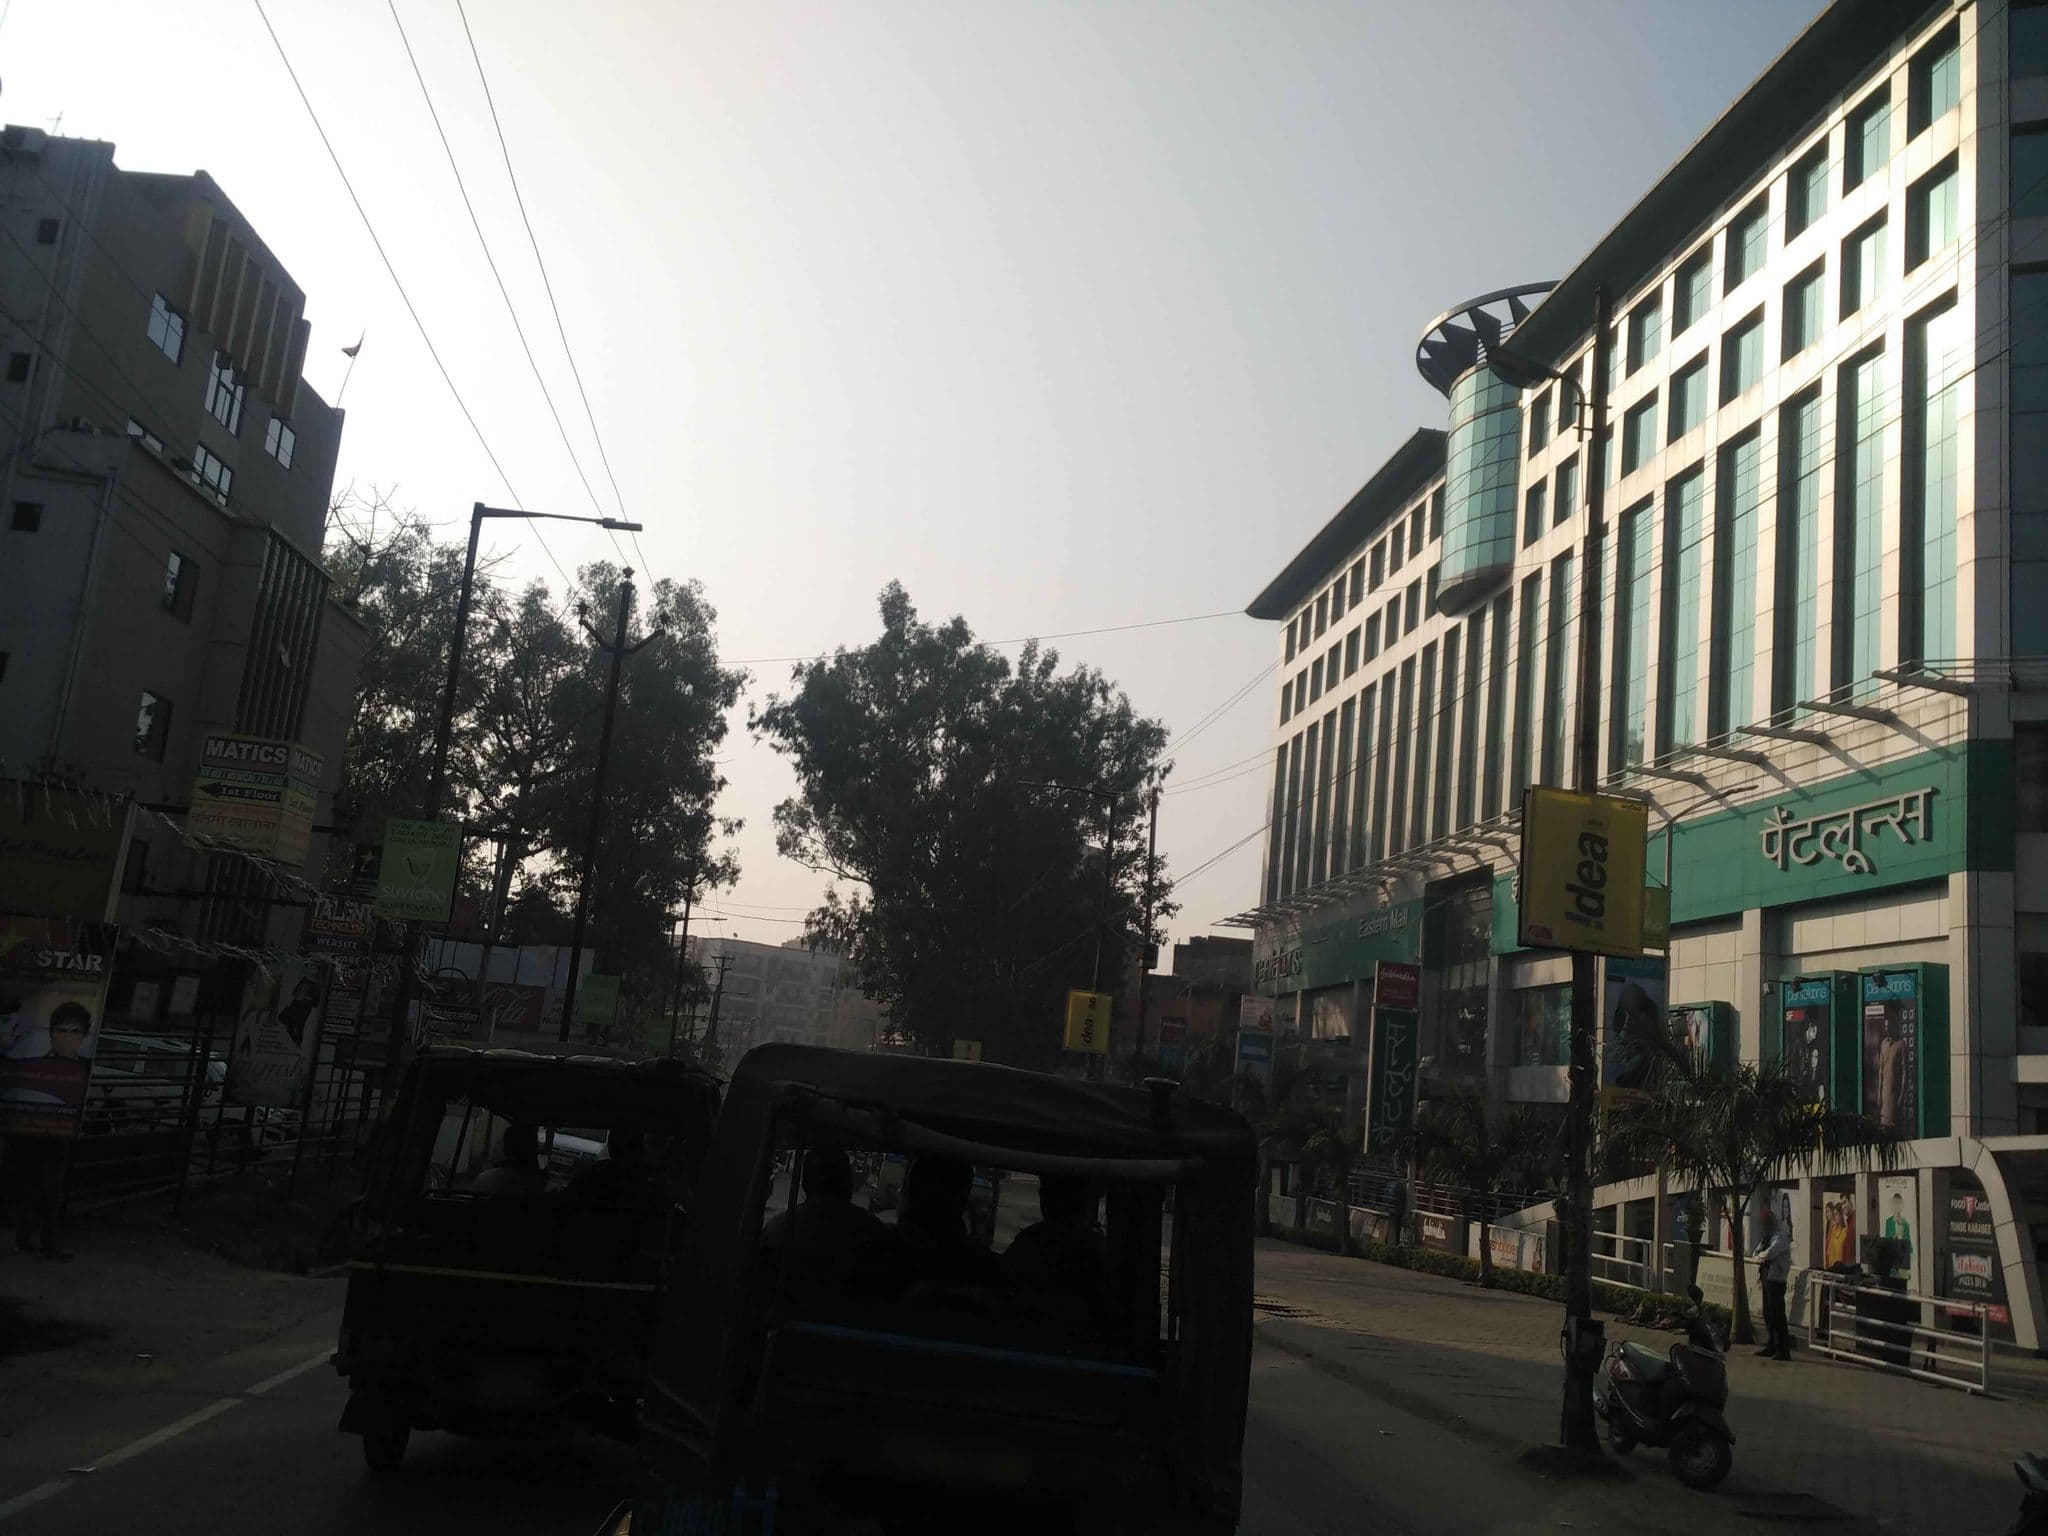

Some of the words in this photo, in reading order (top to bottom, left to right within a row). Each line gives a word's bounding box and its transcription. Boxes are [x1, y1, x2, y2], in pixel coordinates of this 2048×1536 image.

[240, 787, 279, 801] Floor
[1760, 786, 1935, 874] पैंटलून्स
[37, 950, 103, 972] STAR
